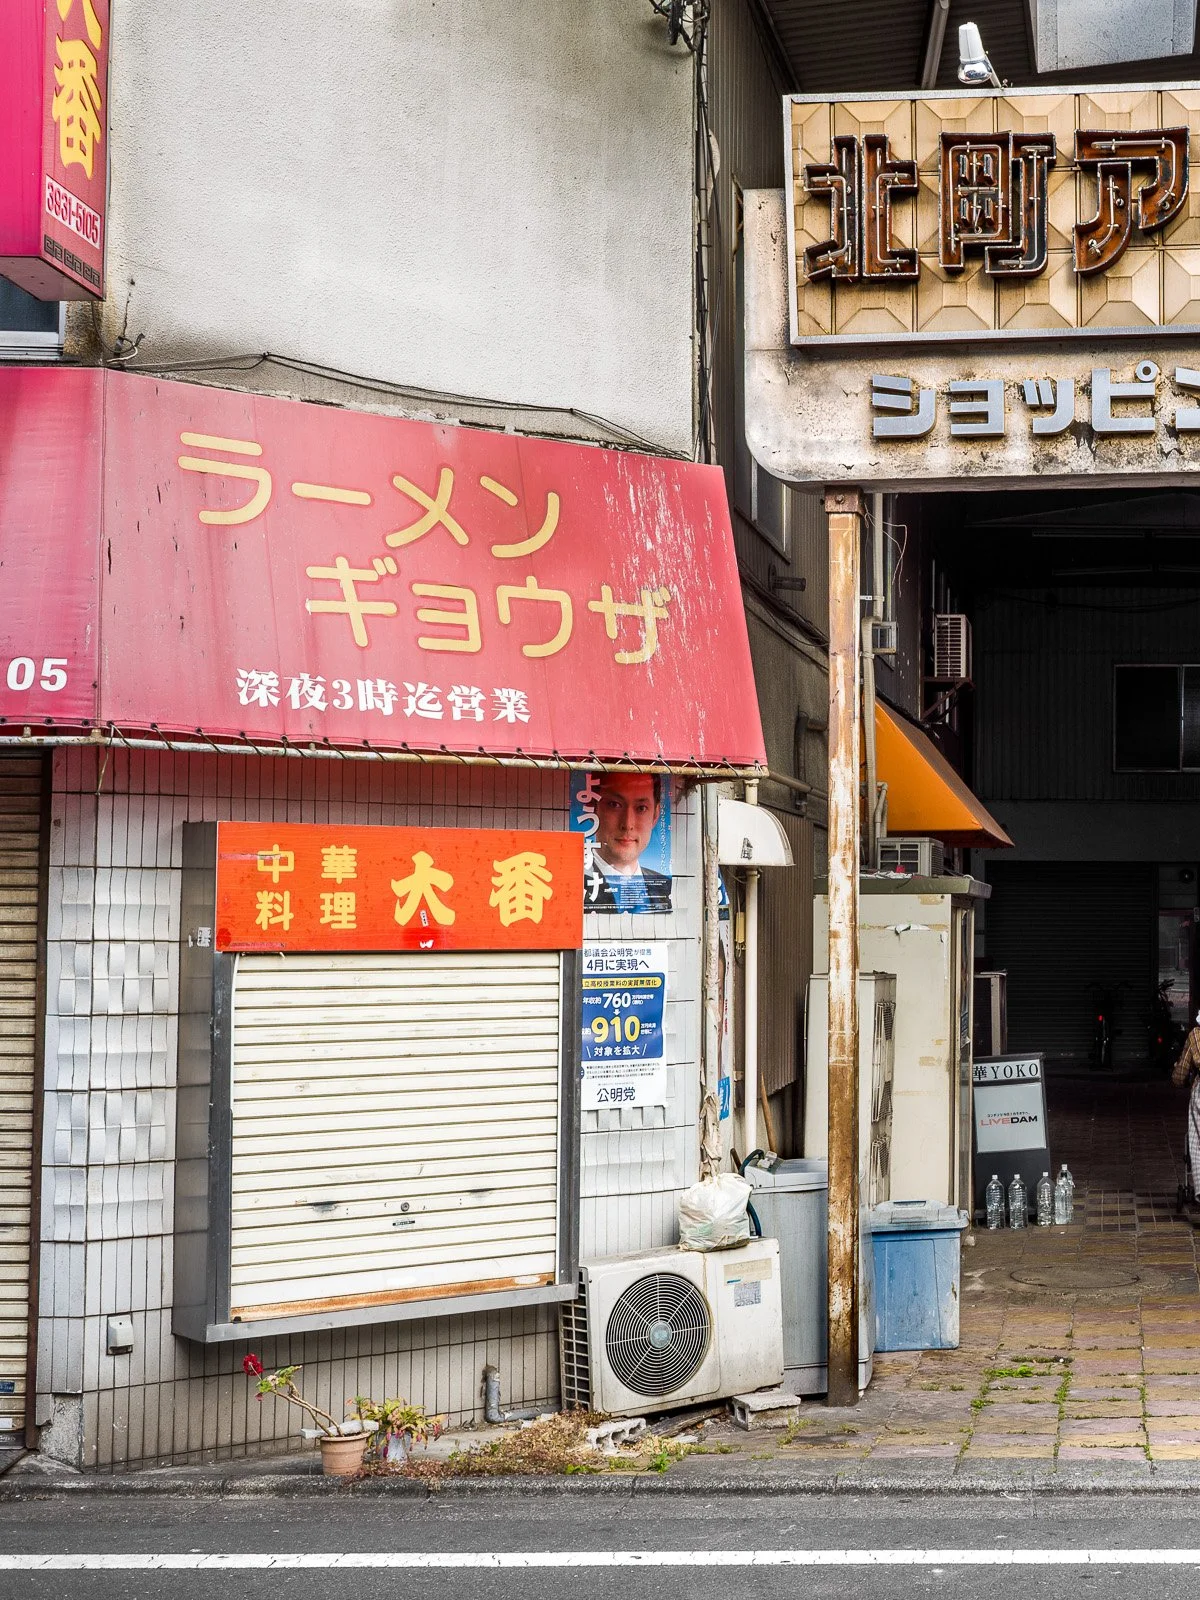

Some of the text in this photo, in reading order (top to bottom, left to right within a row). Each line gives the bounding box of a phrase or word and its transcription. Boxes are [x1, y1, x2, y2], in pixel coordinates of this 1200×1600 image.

[47, 181, 99, 245] 3931-5105
[178, 431, 560, 558] ラーメン
[305, 556, 671, 665] ギョウザ
[7, 656, 68, 691] 05
[236, 668, 531, 723] 深夜3時迄営業
[257, 845, 358, 884] 中華
[391, 851, 554, 927] 大番
[255, 891, 358, 931] 料理
[587, 959, 650, 971] 4月に実現へ
[602, 992, 631, 1008] 760
[591, 1016, 640, 1043] 910
[594, 1045, 641, 1057] 対象を拡大
[597, 1087, 636, 1103] 公明党
